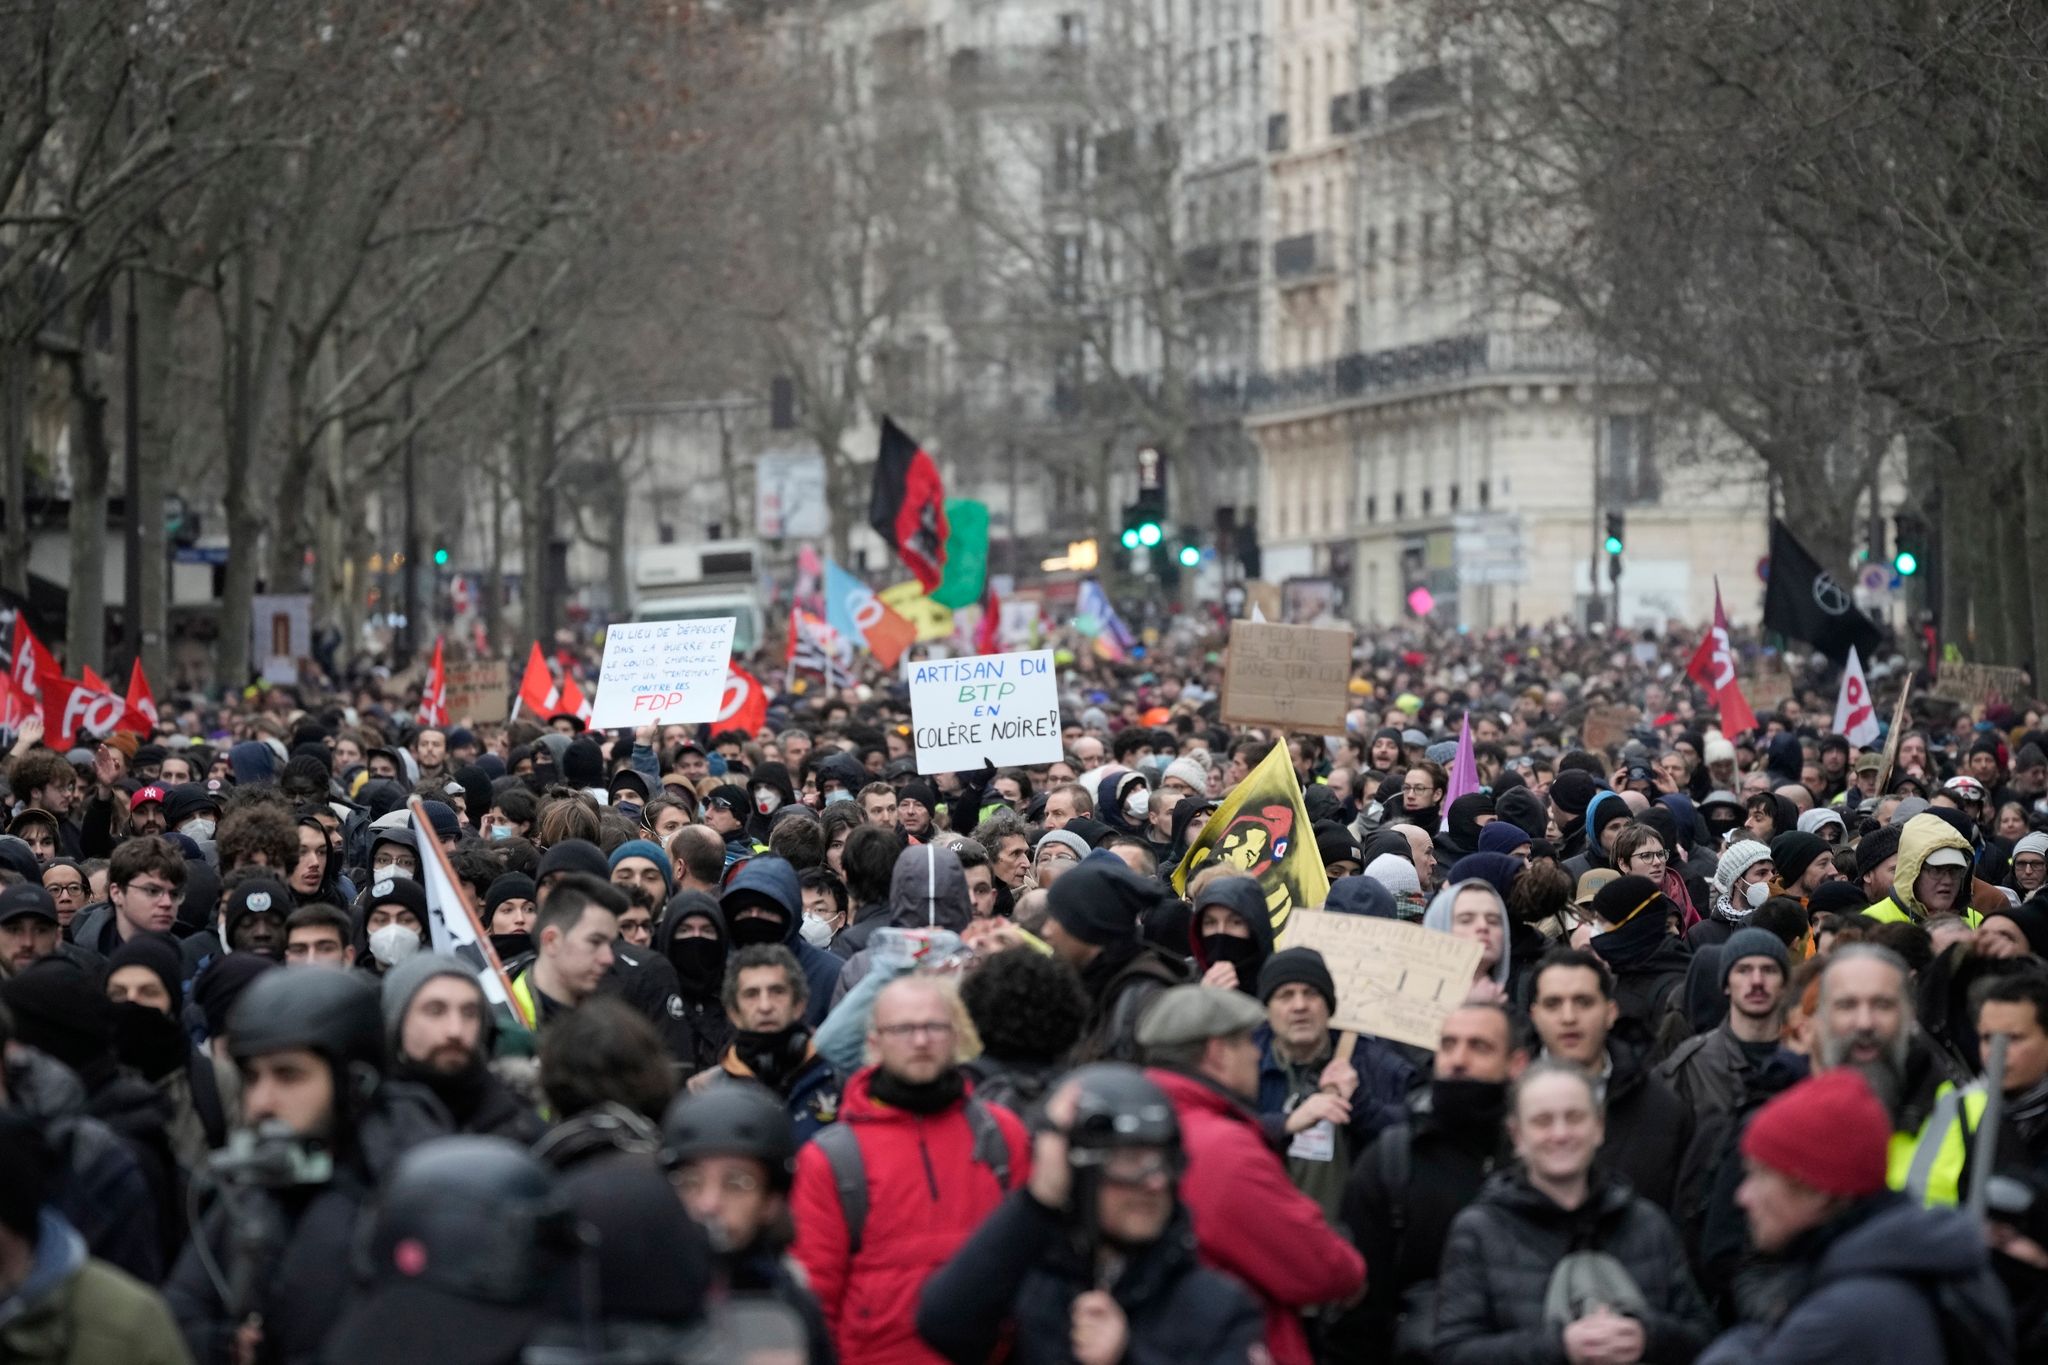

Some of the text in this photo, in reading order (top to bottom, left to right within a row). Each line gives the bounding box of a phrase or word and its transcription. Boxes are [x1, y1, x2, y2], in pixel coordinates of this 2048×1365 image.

[610, 629, 624, 641] AU
[628, 628, 651, 640] LIEU
[656, 627, 671, 638] DE
[642, 645, 656, 653] LA
[710, 640, 725, 650] ET
[606, 660, 618, 670] LE
[1020, 658, 1047, 676] DU
[642, 670, 656, 680] UN
[631, 682, 691, 693] CONTRE LES
[958, 682, 1017, 703] BTP
[633, 692, 683, 712] FDP
[62, 686, 126, 740] FO
[973, 704, 1001, 717] EN
[917, 722, 982, 749] COLÈRE
